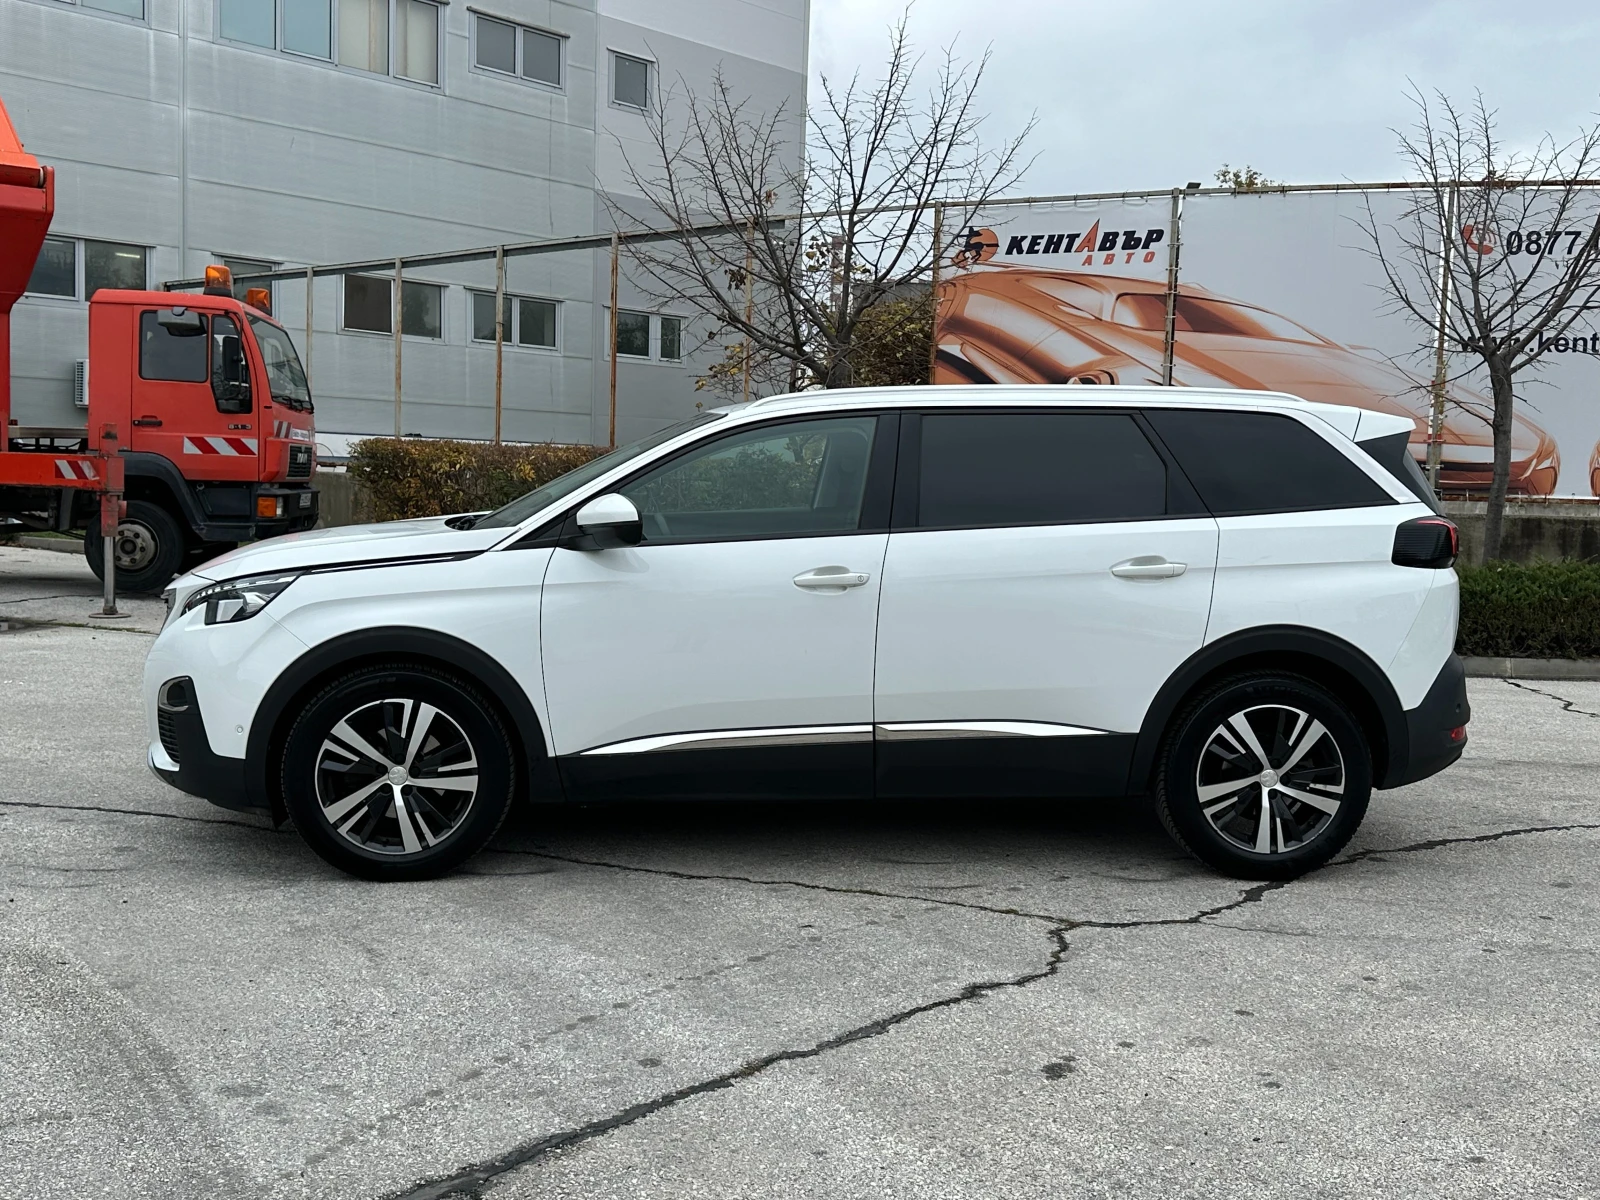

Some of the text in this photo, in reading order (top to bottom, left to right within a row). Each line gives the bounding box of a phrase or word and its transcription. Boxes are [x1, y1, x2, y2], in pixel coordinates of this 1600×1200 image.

[1005, 218, 1164, 256] КЕНТАВЪР
[1506, 230, 1582, 256] 0877
[1082, 252, 1156, 266] АВТО
